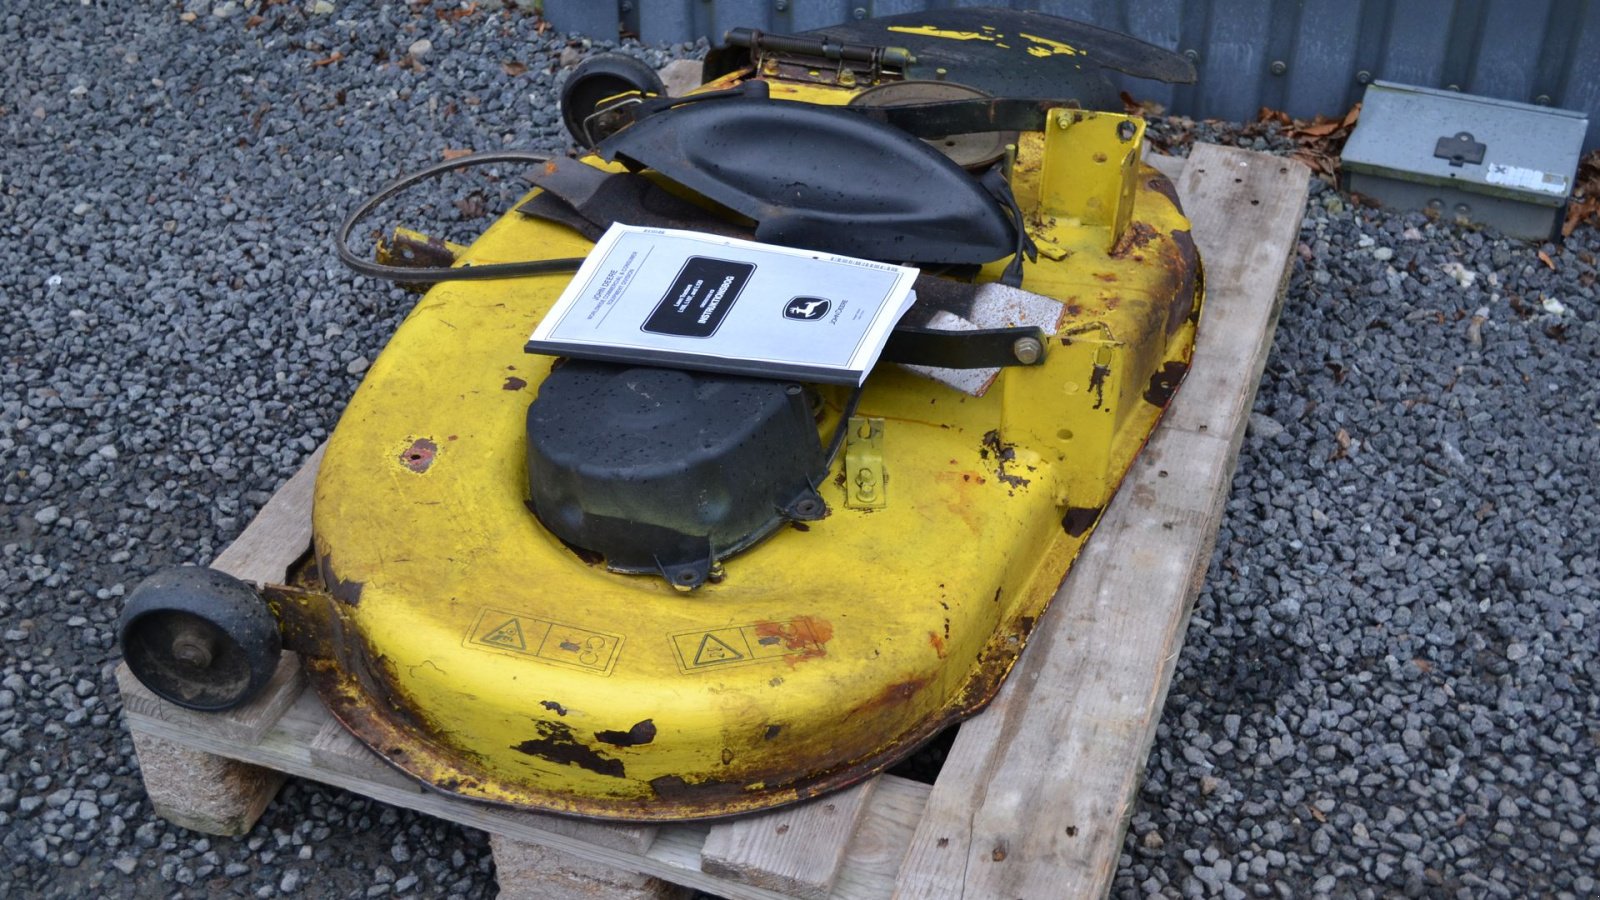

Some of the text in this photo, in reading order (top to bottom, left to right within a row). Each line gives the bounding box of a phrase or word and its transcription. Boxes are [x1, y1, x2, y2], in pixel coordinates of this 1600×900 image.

[592, 269, 618, 301] JOHN DEERE
[697, 275, 735, 324] INSTRUKTIONSBOG
